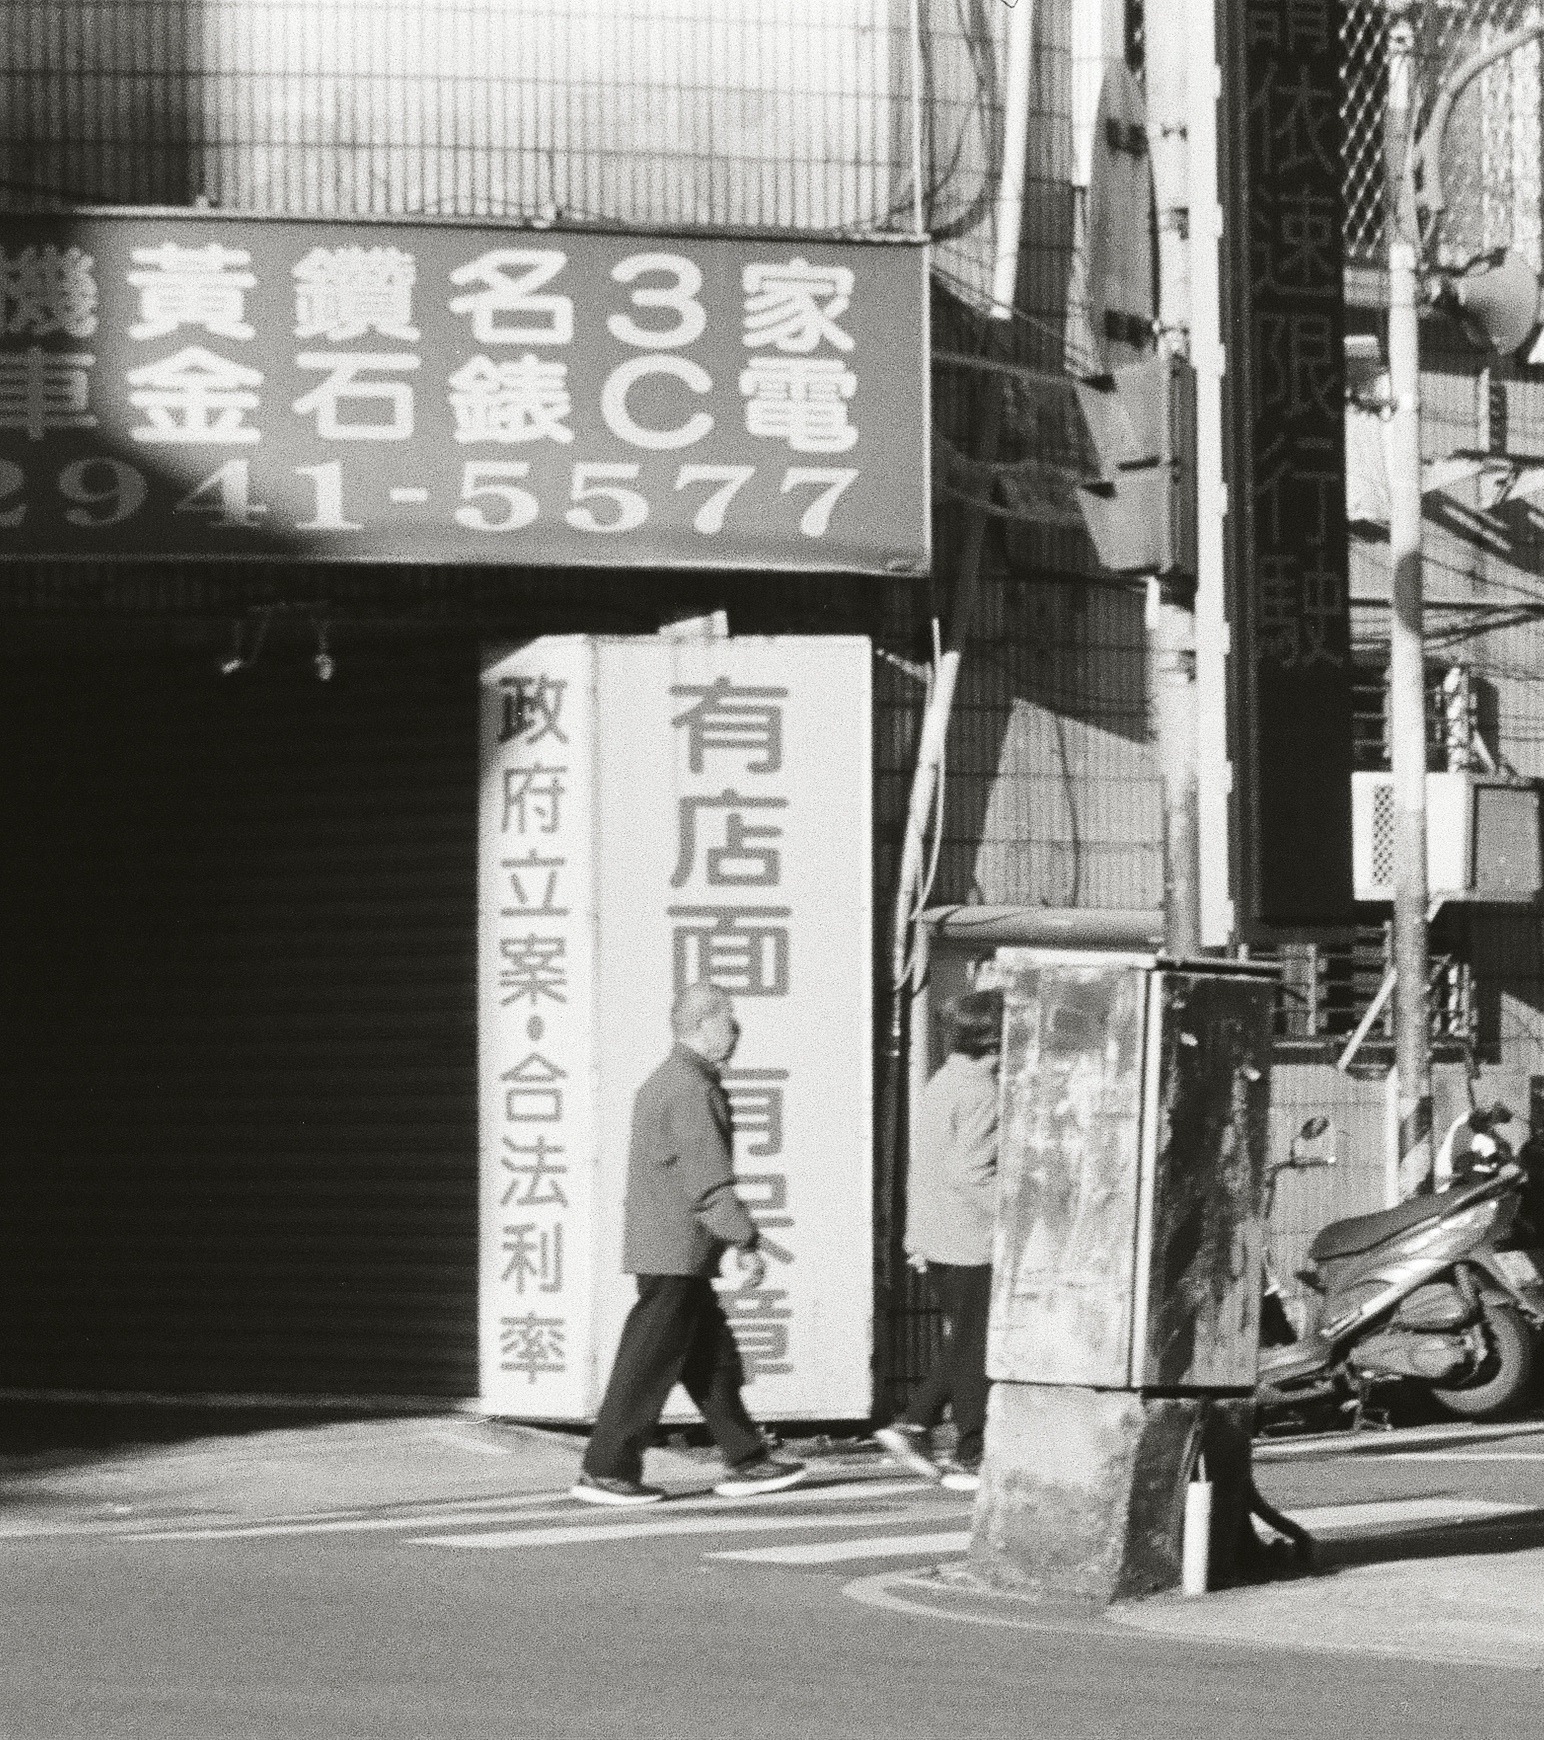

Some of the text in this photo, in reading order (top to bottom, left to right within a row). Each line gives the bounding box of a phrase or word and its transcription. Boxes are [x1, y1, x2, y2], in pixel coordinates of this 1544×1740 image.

[126, 243, 262, 444] 黃金
[292, 246, 420, 441] 鑽石
[448, 248, 575, 445] 名錶
[602, 253, 715, 449] 3C
[739, 258, 858, 454] 家電
[667, 676, 792, 998] 有店面
